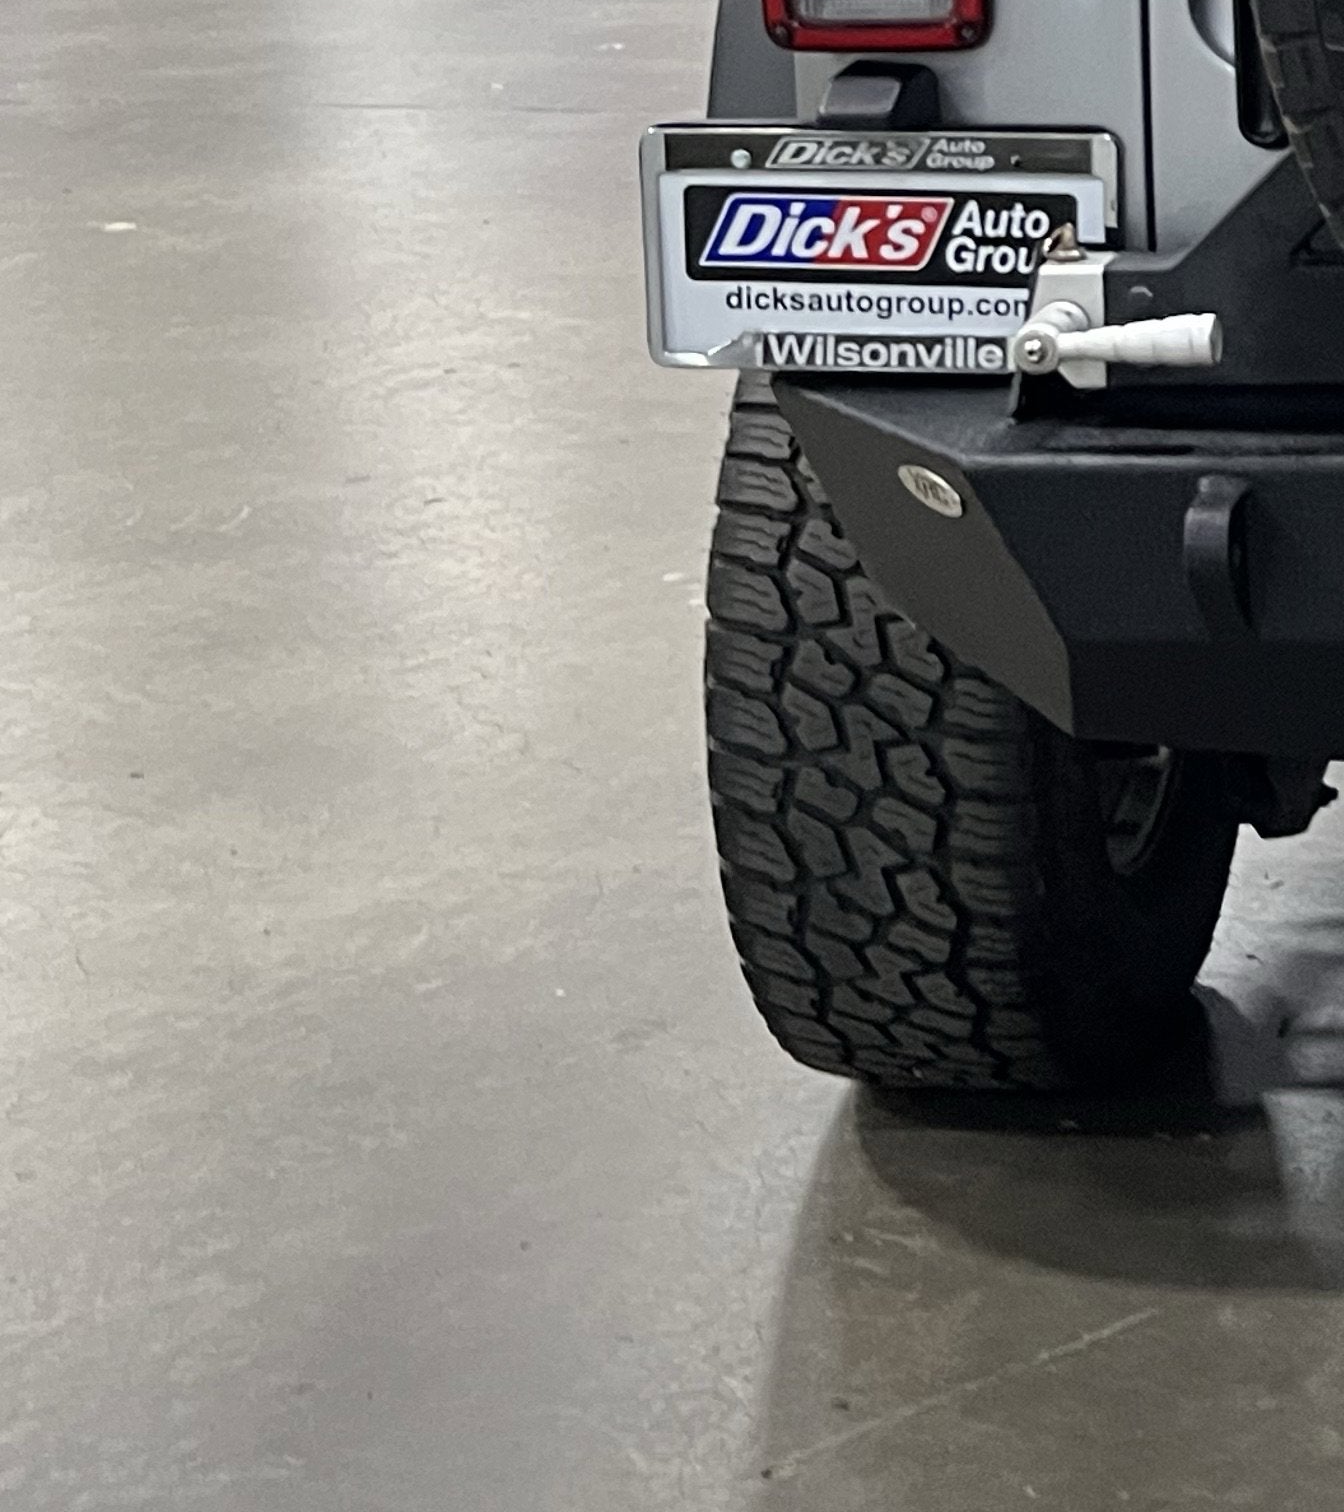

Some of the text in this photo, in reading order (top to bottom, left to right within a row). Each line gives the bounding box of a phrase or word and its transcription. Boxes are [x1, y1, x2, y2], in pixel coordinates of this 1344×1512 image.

[926, 153, 995, 171] Group
[931, 139, 986, 154] Auto
[717, 199, 1050, 261] Dick's Auto
[945, 235, 1038, 275] Grou
[767, 334, 1005, 369] Wilsonville
